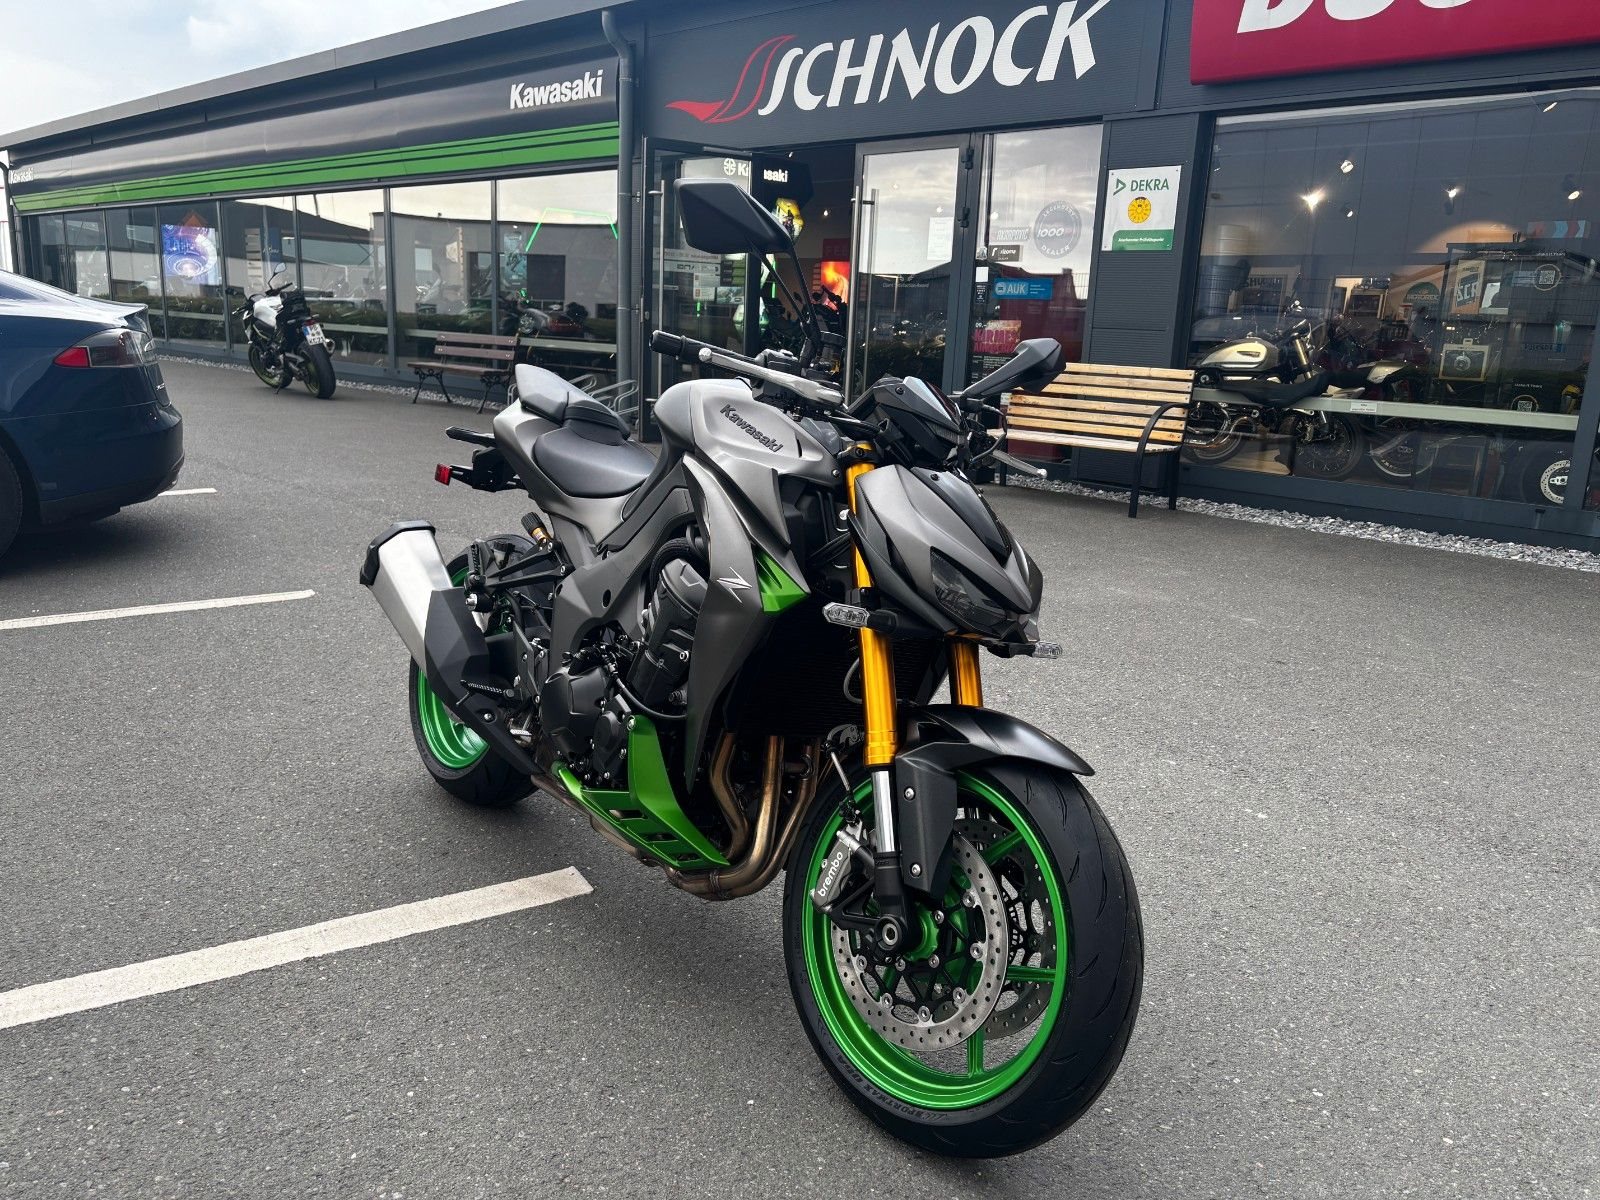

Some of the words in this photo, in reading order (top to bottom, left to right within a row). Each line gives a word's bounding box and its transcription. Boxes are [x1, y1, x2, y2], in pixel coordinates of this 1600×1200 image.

[757, 0, 1109, 116] SCHNOCK
[510, 69, 603, 109] Kawasaki
[1130, 178, 1169, 192] DEKRA
[1041, 244, 1071, 256] DEALER
[1007, 283, 1026, 294] AUK
[720, 403, 784, 453] Kawasaki
[817, 851, 844, 897] brembo
